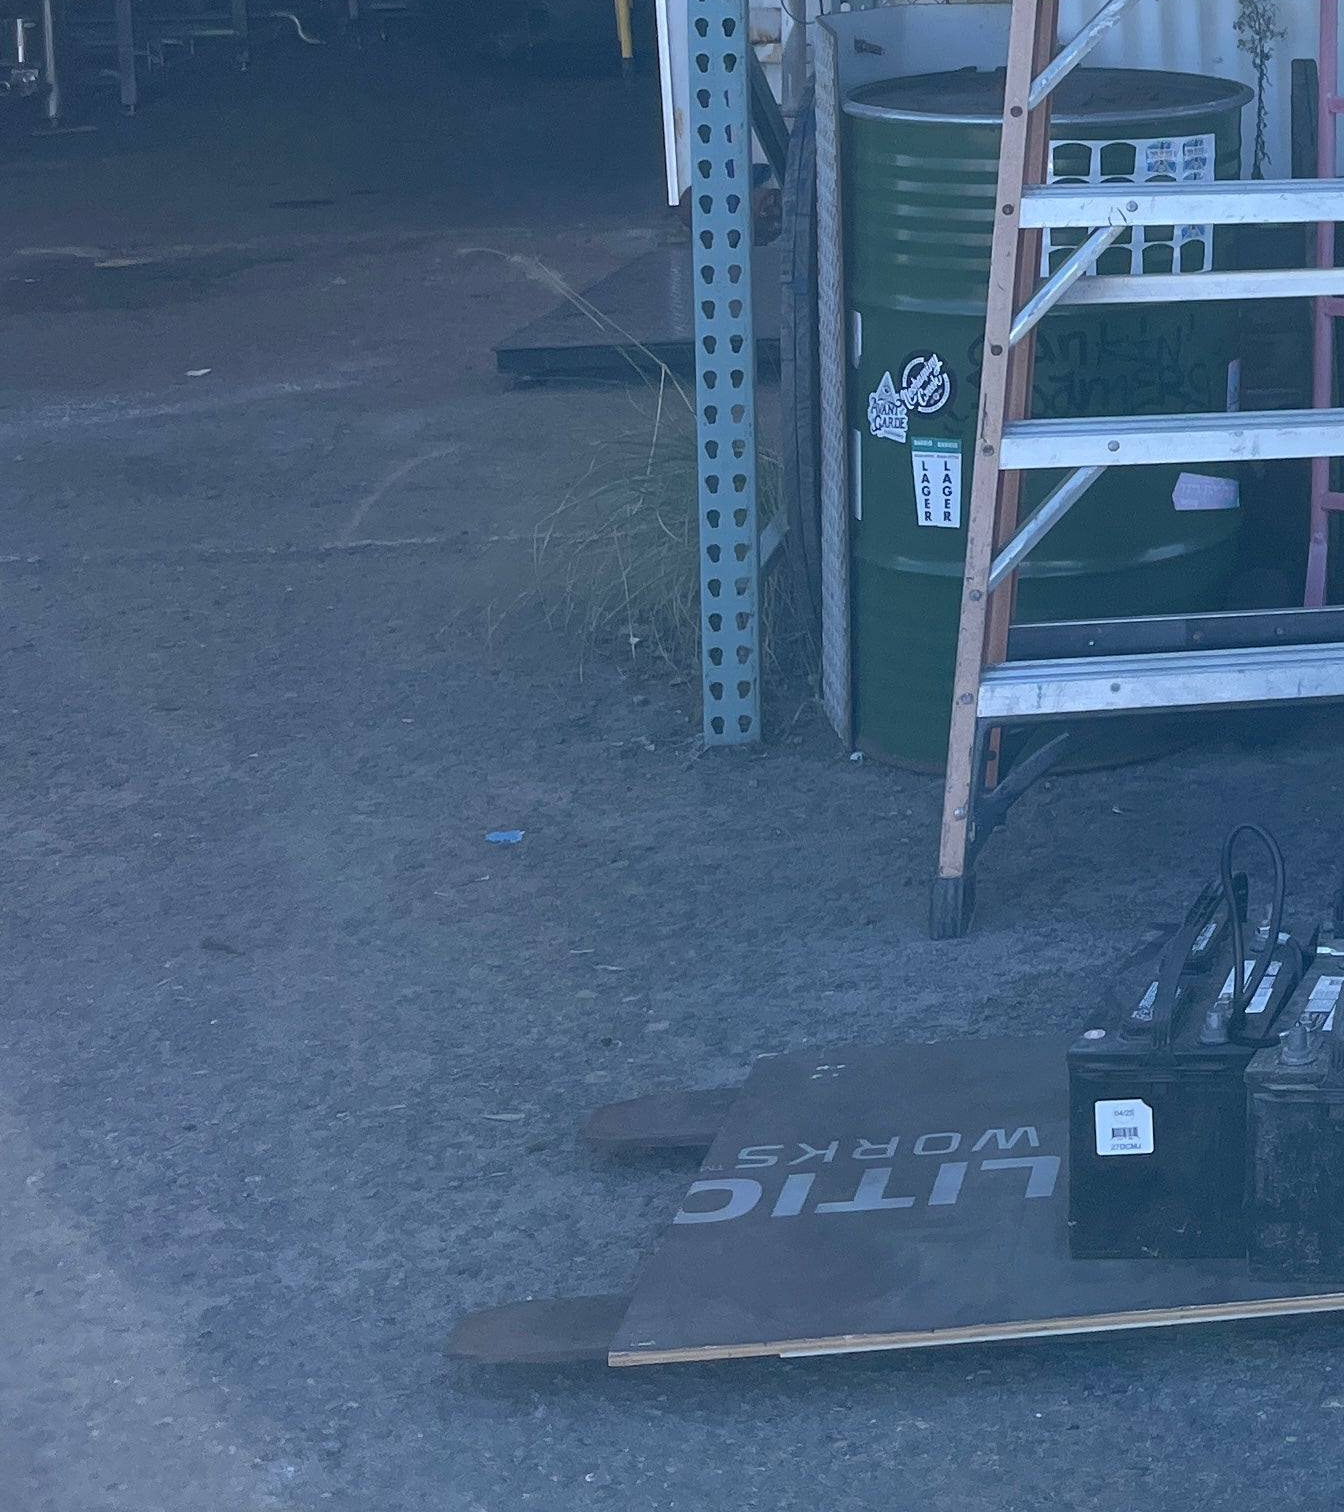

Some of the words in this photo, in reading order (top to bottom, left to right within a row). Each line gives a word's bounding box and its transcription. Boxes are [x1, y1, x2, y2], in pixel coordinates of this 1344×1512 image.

[870, 397, 901, 416] AVANT
[873, 415, 906, 430] GARDE
[921, 460, 932, 522] LAGER
[942, 460, 953, 522] LAGER
[736, 1125, 1040, 1169] WORKS
